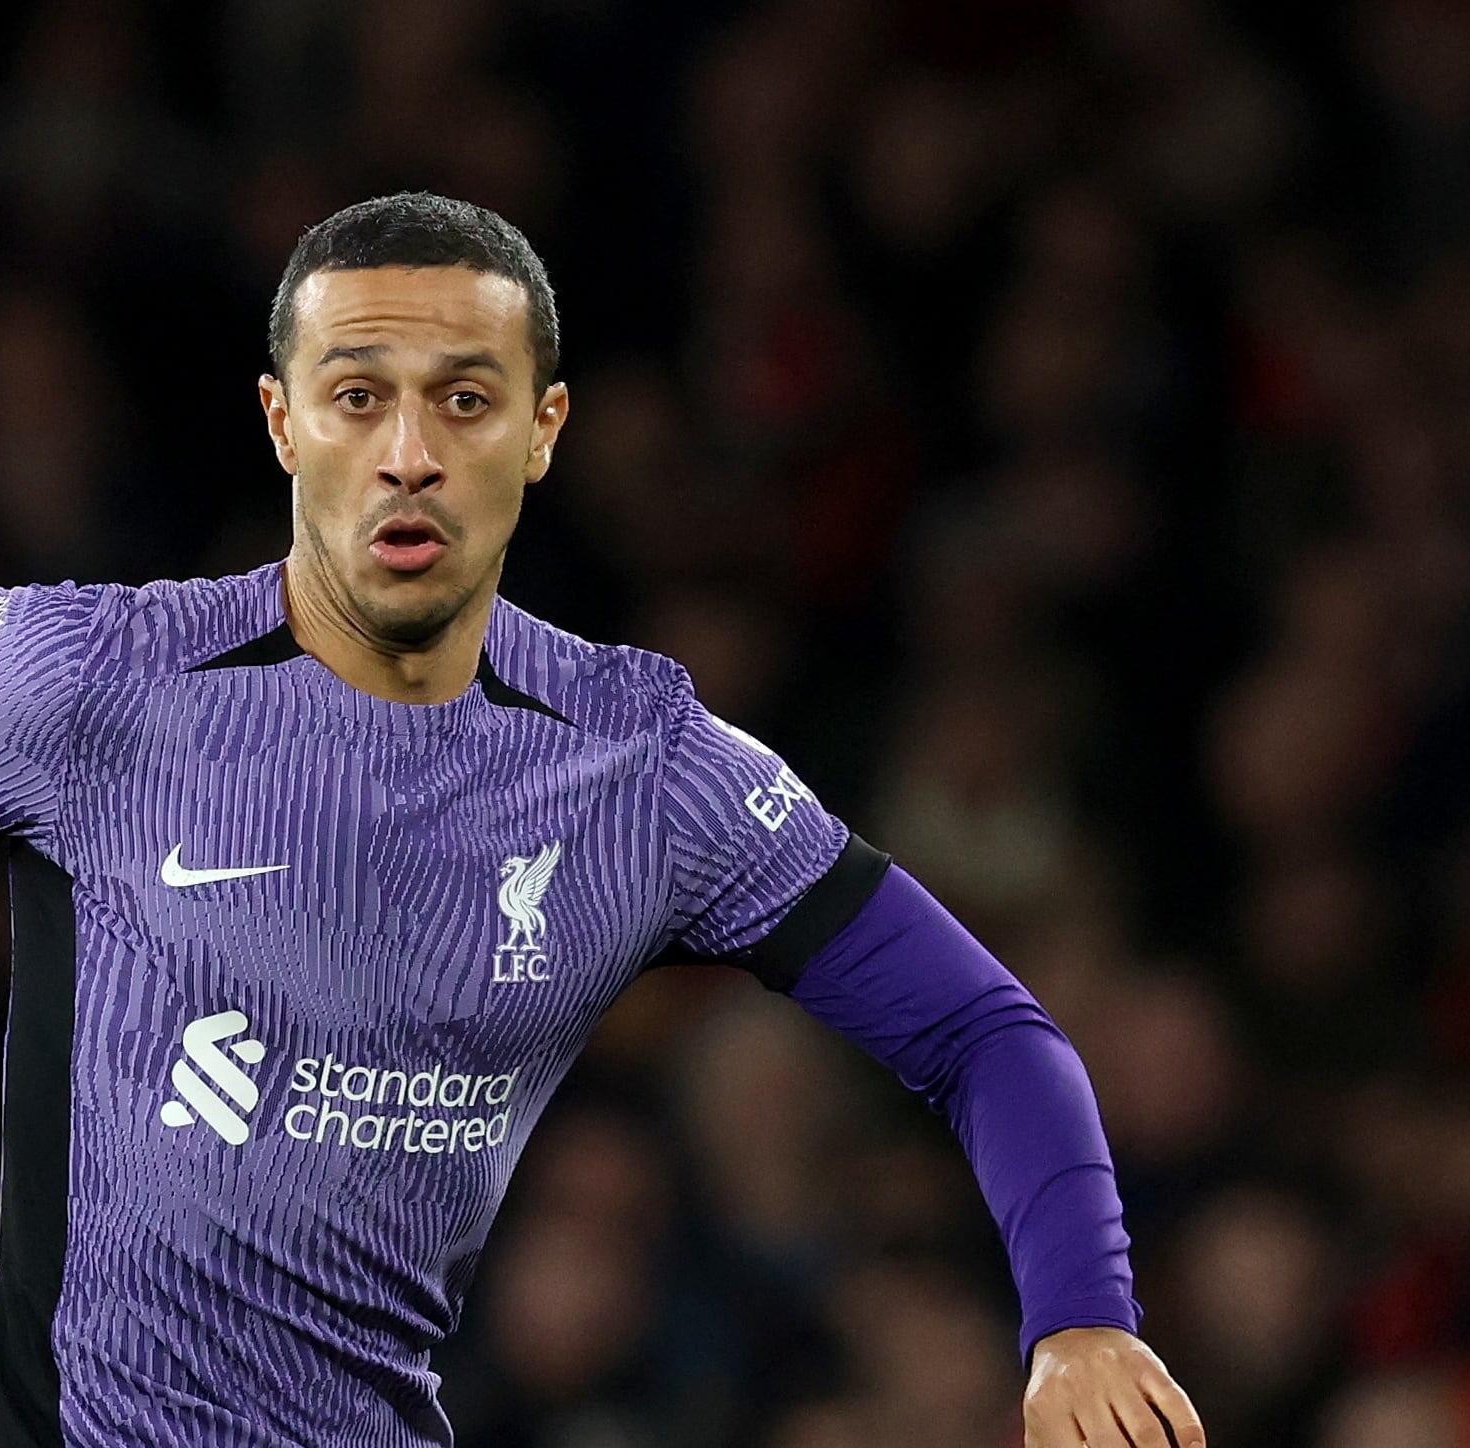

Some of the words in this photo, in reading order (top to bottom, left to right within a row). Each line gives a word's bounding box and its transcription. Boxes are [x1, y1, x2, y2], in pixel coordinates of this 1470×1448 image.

[492, 954, 550, 982] L.F.C.
[291, 1052, 521, 1108] standard
[284, 1100, 512, 1155] chartered
